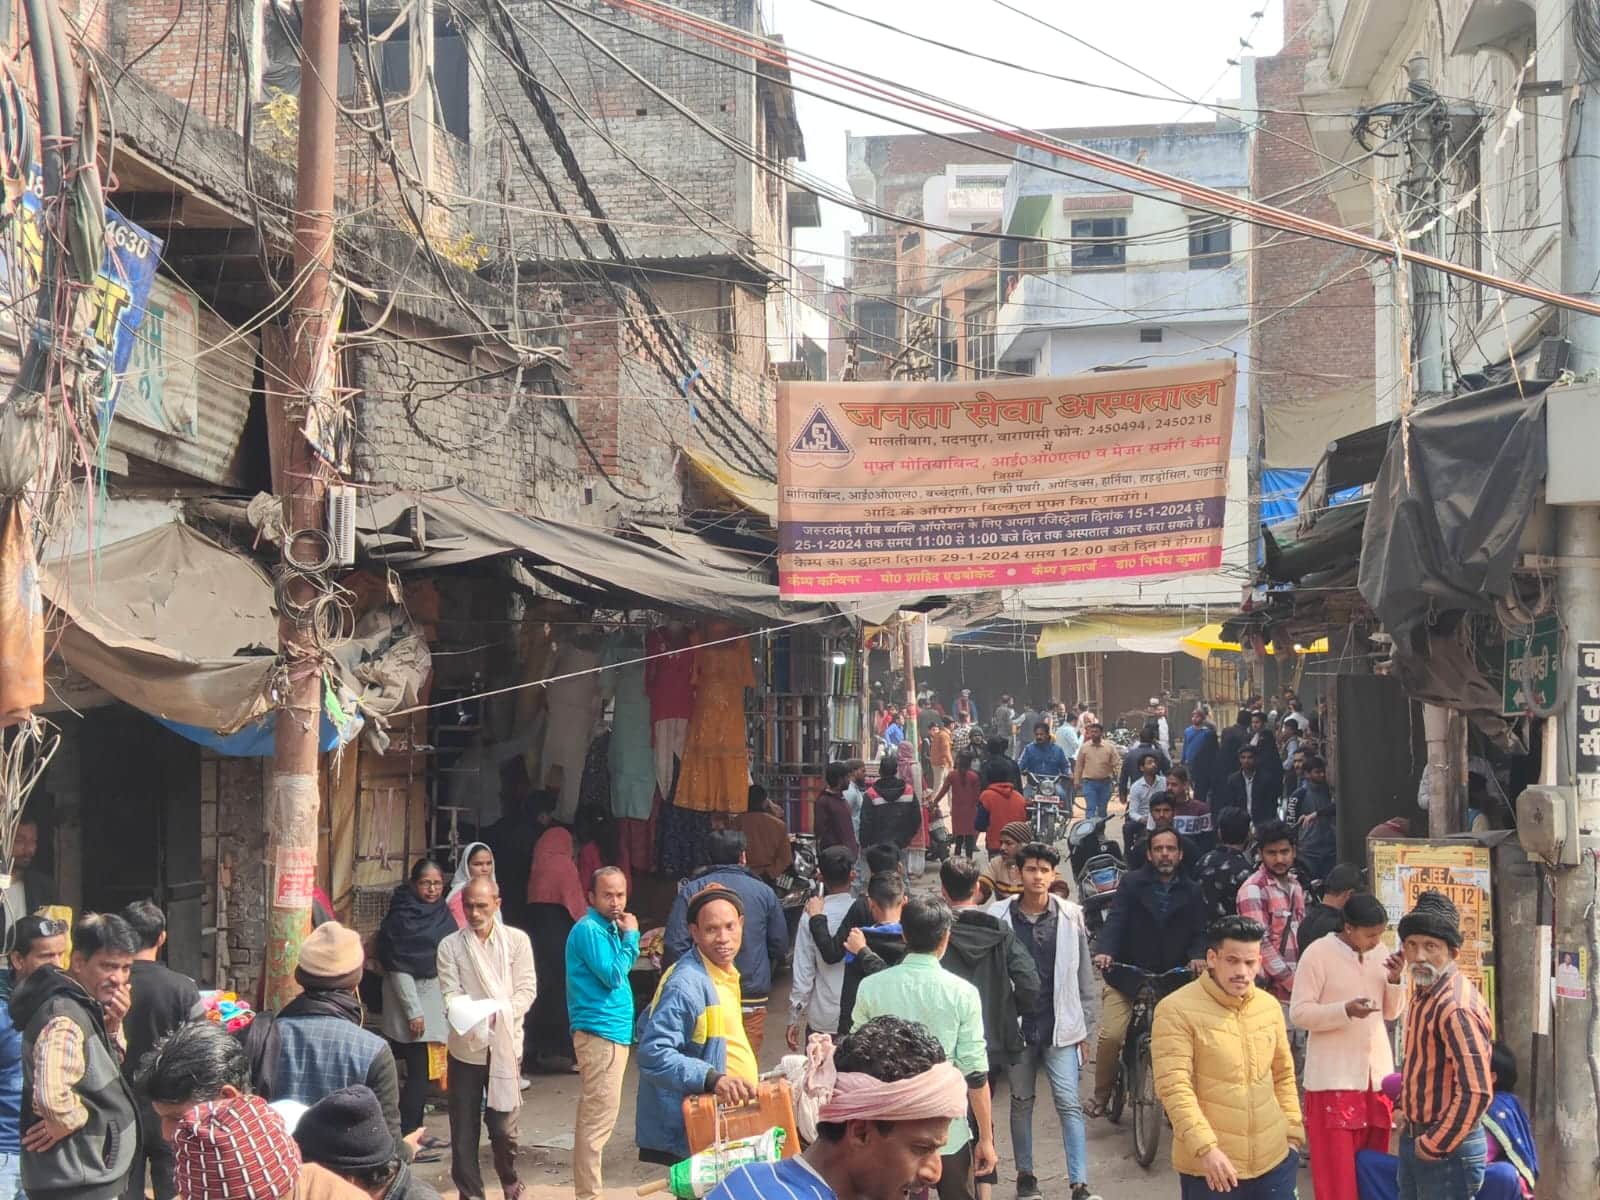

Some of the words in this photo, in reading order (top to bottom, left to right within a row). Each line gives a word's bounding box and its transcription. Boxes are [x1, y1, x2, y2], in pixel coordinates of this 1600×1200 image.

[839, 402, 960, 430] जनता
[960, 391, 1052, 428] सेवा
[1056, 379, 1226, 419] अस्पताल
[996, 427, 1050, 441] वाराणसी
[1087, 420, 1151, 435] 2450494,
[1155, 414, 1213, 429] 2450218
[1043, 440, 1054, 451] में
[1096, 448, 1108, 458] व
[1112, 443, 1145, 457] मेजर
[1148, 437, 1187, 454] सर्जरी
[999, 483, 1013, 494] की
[854, 522, 882, 536] गरीब
[884, 521, 915, 534] व्यक्ति
[968, 518, 978, 530] के
[981, 518, 1002, 530] लिए
[1005, 516, 1035, 527] अपना
[1091, 510, 1124, 525] दिनांक
[1128, 503, 1193, 520] 15-1-2024
[1195, 500, 1205, 513] से
[864, 506, 896, 518] आदि
[900, 505, 914, 516] के
[794, 538, 862, 551] 25-1-2024
[865, 538, 883, 549] तक
[887, 537, 913, 549] समय
[916, 534, 953, 547] 11:00
[956, 533, 965, 546] से
[969, 533, 998, 546] 1:00
[1000, 532, 1018, 544] बजे
[1022, 530, 1041, 544] दिन
[1044, 530, 1063, 541] तक
[1065, 526, 1109, 540] अस्पताल
[1112, 523, 1143, 536] आकर
[1145, 521, 1165, 533] करा
[1167, 516, 1194, 530] सकते
[824, 557, 843, 567] का
[896, 553, 937, 566] दिनांक
[941, 550, 1020, 562] 29-1-2024
[1024, 549, 1056, 560] समय
[1109, 542, 1130, 553] बजे
[1134, 539, 1157, 551] दिन
[1412, 885, 1419, 900] 9
[1462, 888, 1474, 904] 12
